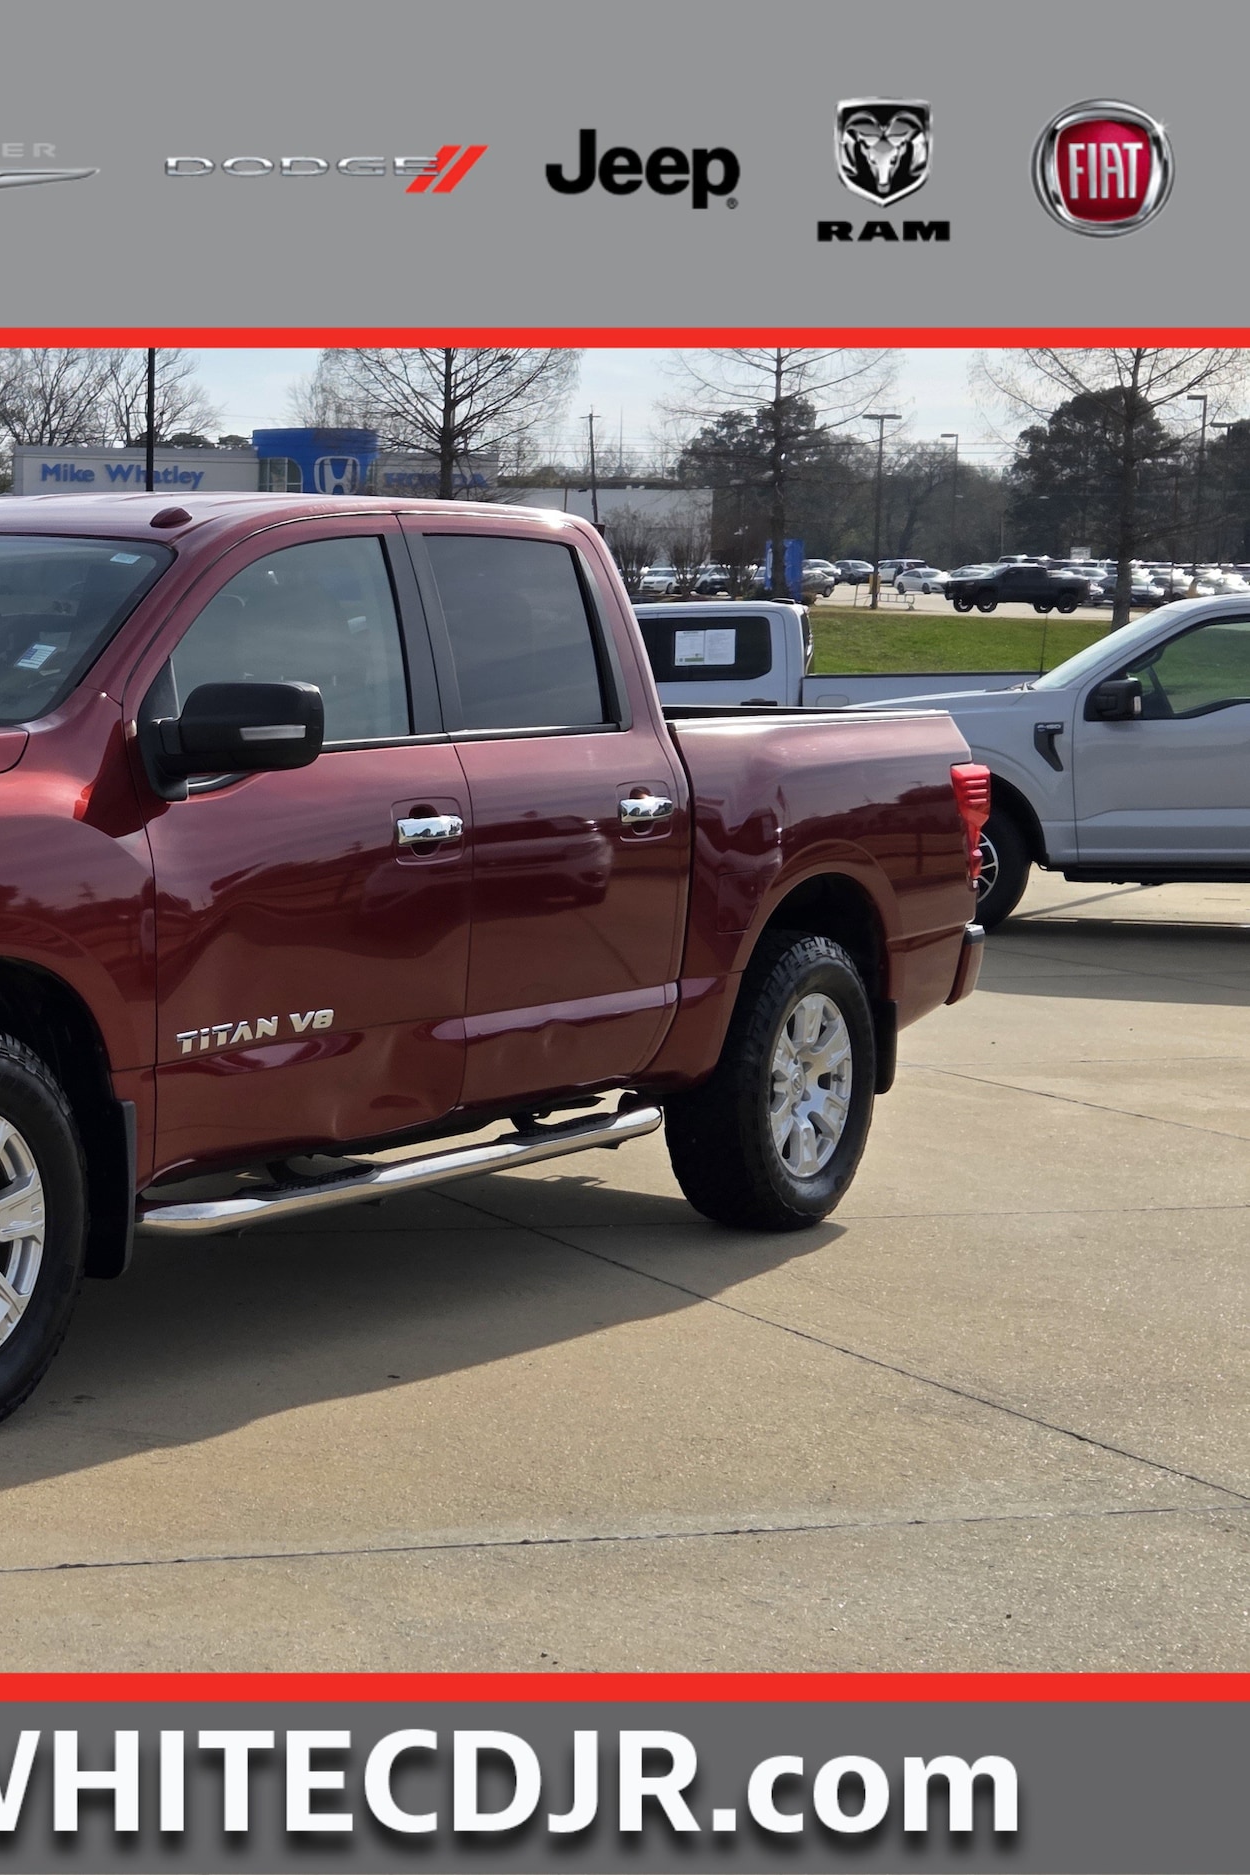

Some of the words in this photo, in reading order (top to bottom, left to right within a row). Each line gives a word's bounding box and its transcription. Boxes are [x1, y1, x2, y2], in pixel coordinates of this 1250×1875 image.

[41, 463, 95, 482] Mike
[105, 463, 205, 490] Whatley
[384, 472, 490, 489] HONDA
[176, 1016, 278, 1054] TITAN
[289, 1008, 334, 1033] V8
